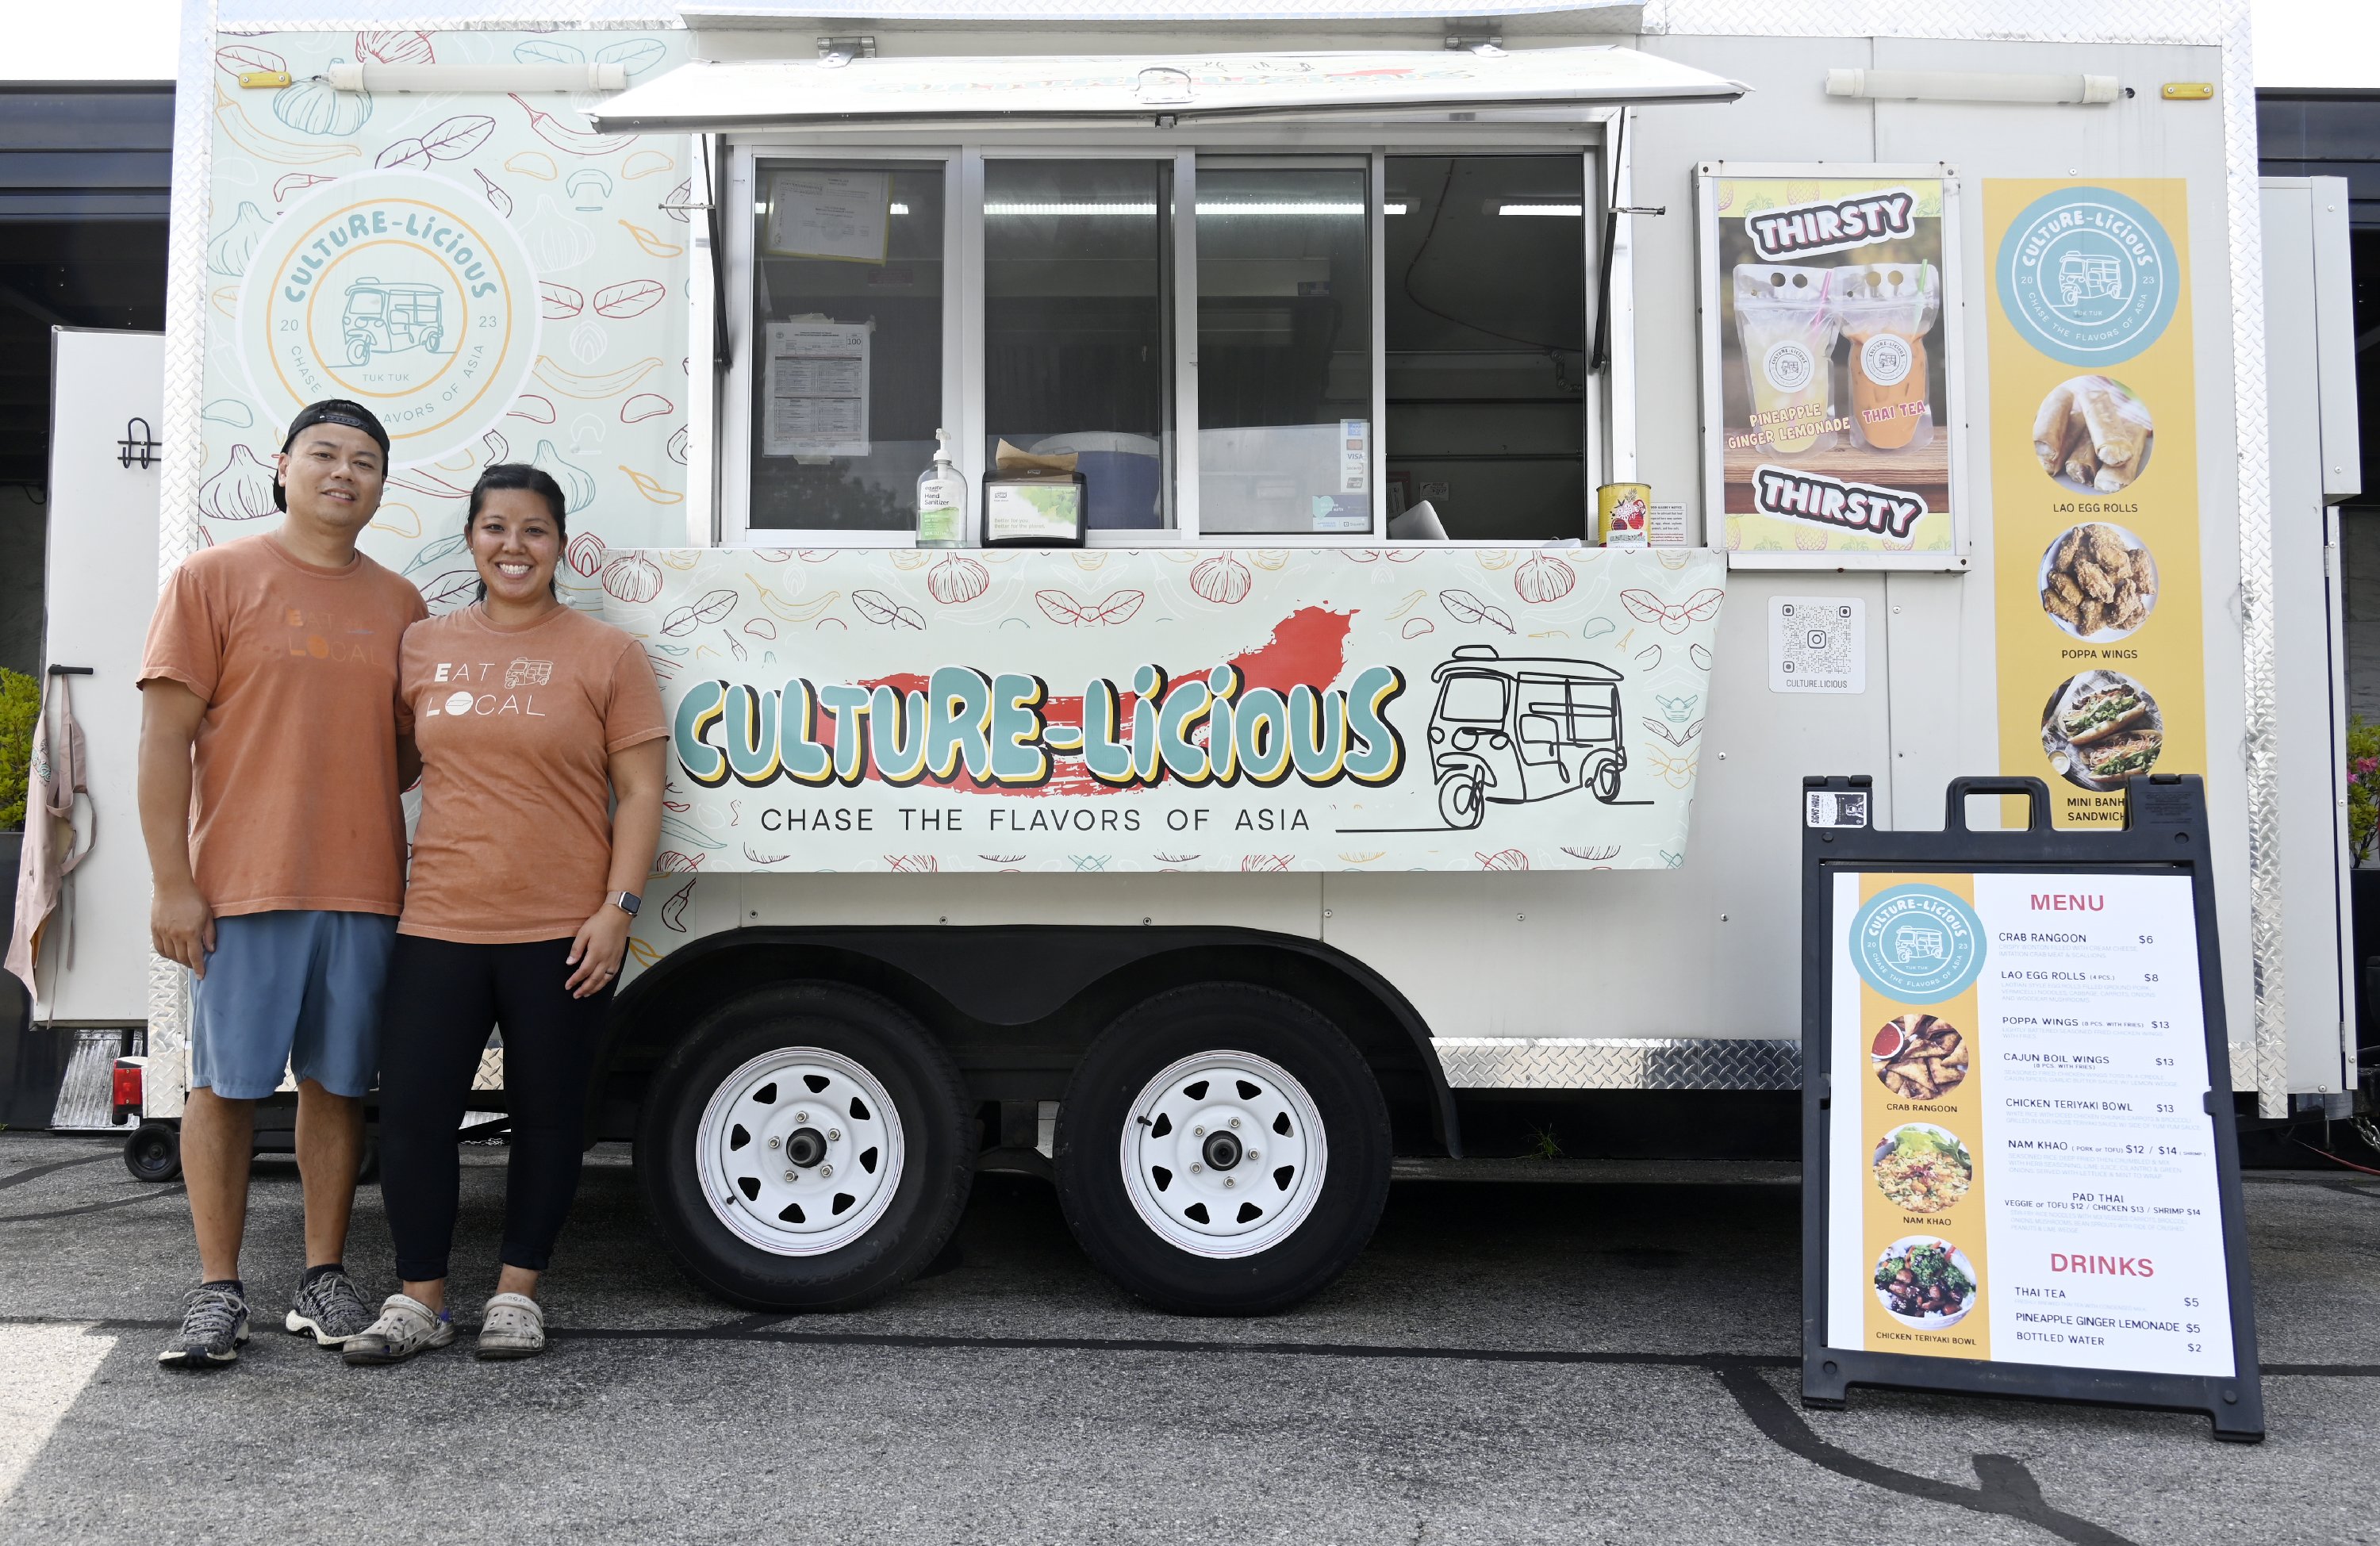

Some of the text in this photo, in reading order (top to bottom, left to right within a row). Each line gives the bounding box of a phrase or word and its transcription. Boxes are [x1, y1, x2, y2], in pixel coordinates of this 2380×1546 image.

[1754, 196, 1910, 251] THIRSTY
[281, 320, 298, 332] 20
[479, 316, 497, 328] 23
[2029, 293, 2147, 340] CHASE THE FLAVORS OF ASIA
[292, 346, 321, 393] CHASE
[443, 383, 459, 401] OF
[463, 344, 484, 378] ASIA
[1749, 404, 1821, 428] PINEAPPLE
[1863, 400, 1925, 424] THAI TEA
[1728, 417, 1851, 449] GINGER LEMONADE
[1761, 473, 1919, 535] THIRSTY
[2062, 650, 2138, 658] POPPA WINGS
[434, 663, 495, 682] EAT
[426, 691, 546, 717] LOCAL
[760, 807, 1310, 832] CHASE THE FLAVORS OF ASIA
[2031, 895, 2103, 911] MENU
[1999, 932, 2153, 944] CRAB RANGOON $6
[1873, 953, 1887, 973] CHASE
[1890, 974, 1903, 984] THE
[1907, 978, 1940, 987] FLAVORS
[1952, 955, 1962, 969] ASIA
[2052, 972, 2086, 980] ROLLS
[2144, 973, 2159, 982] $8
[2042, 1018, 2079, 1026] WINGS
[2044, 1054, 2068, 1063] BOIL
[2155, 1057, 2174, 1066] $13
[2006, 1099, 2174, 1113] CHICKEN TERIYAKI BOWL $13
[2009, 1140, 2033, 1149] NAM
[2037, 1141, 2067, 1150] KHAO
[2125, 1145, 2144, 1154] $12
[2159, 1146, 2177, 1155] $14
[2098, 1194, 2124, 1203] THAI
[2051, 1253, 2155, 1278] DRINKS
[2014, 1287, 2199, 1306] THAI TEA $5
[2016, 1313, 2201, 1333] PINEAPPLE GINGER LEMONADE $5
[1915, 1334, 1949, 1343] TERIYAKI
[2017, 1332, 2202, 1352] BOTTLED WATER $2
